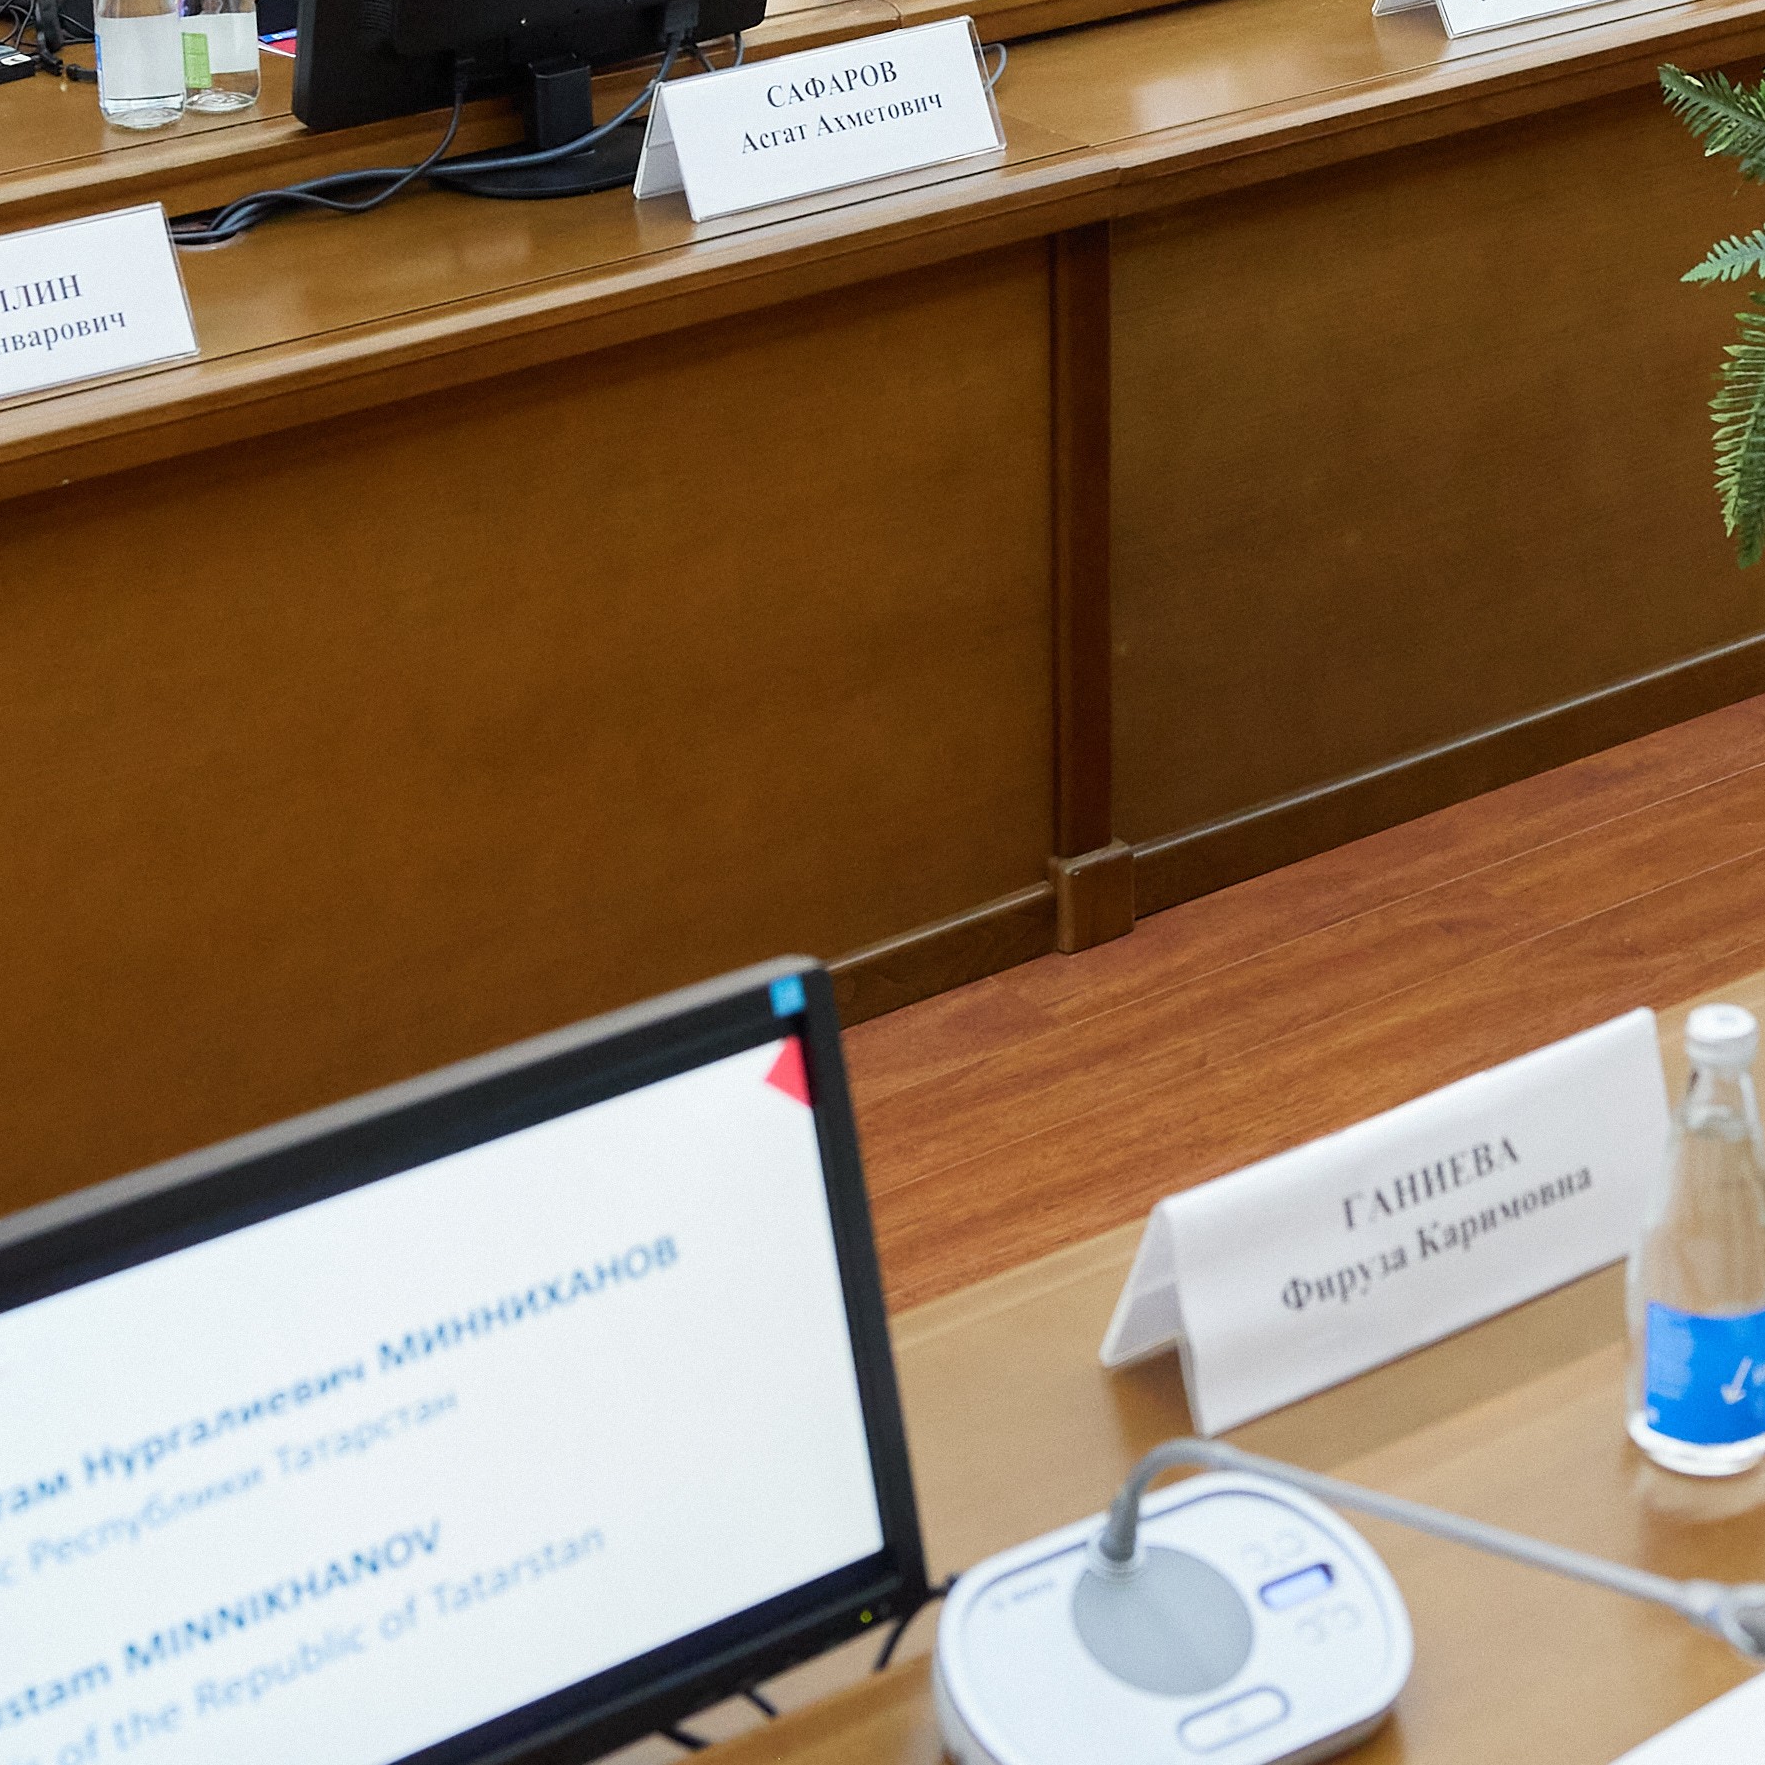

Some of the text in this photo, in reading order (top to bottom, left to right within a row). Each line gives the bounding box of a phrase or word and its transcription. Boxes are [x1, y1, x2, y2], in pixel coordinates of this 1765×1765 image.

[741, 93, 942, 153] Асгат Ахметович
[765, 60, 898, 108] САФАРОВ
[1281, 1167, 1592, 1311] Фируза Каримовна
[1343, 1138, 1521, 1229] ГАНИЕВА
[81, 1362, 366, 1482] Нургалиевич
[376, 1236, 678, 1371] МИННИХАНОВ
[123, 1524, 438, 1670] MINNIKHANOV
